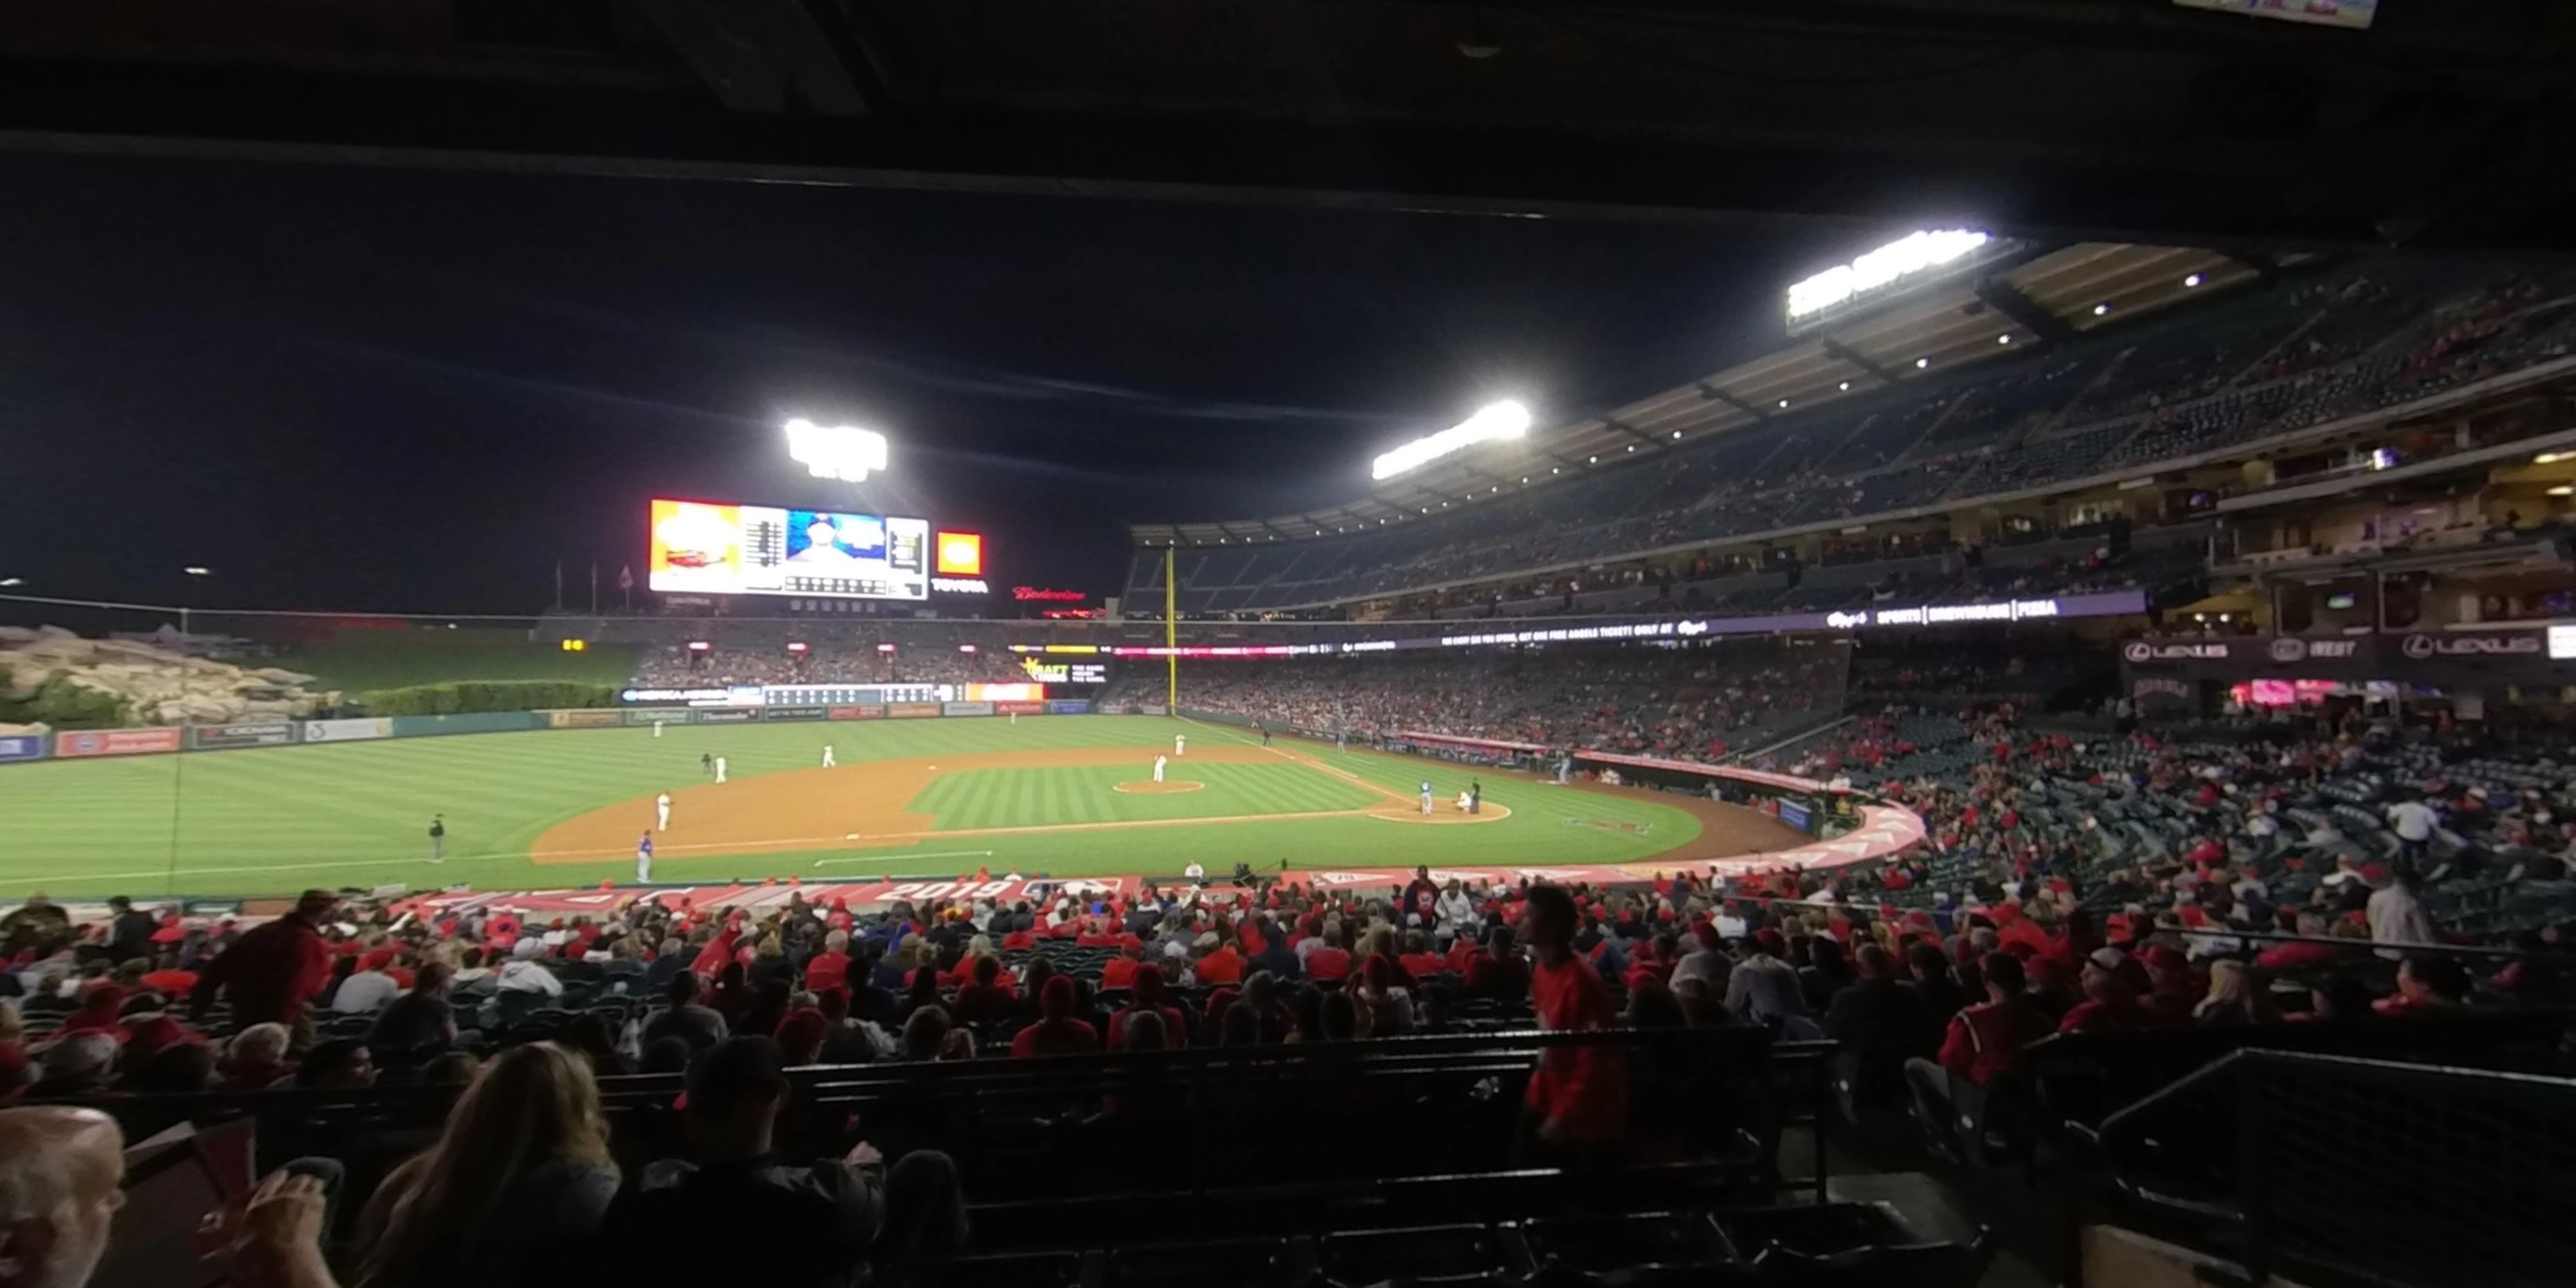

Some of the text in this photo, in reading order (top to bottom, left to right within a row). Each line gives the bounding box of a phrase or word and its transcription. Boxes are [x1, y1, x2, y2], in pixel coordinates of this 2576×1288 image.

[931, 578, 989, 593] TOYOTA
[1877, 608, 1921, 625] SPORTS
[2152, 644, 2228, 658] LEXUS
[2436, 637, 2540, 653] LEXUS
[874, 881, 1013, 902] 2019
